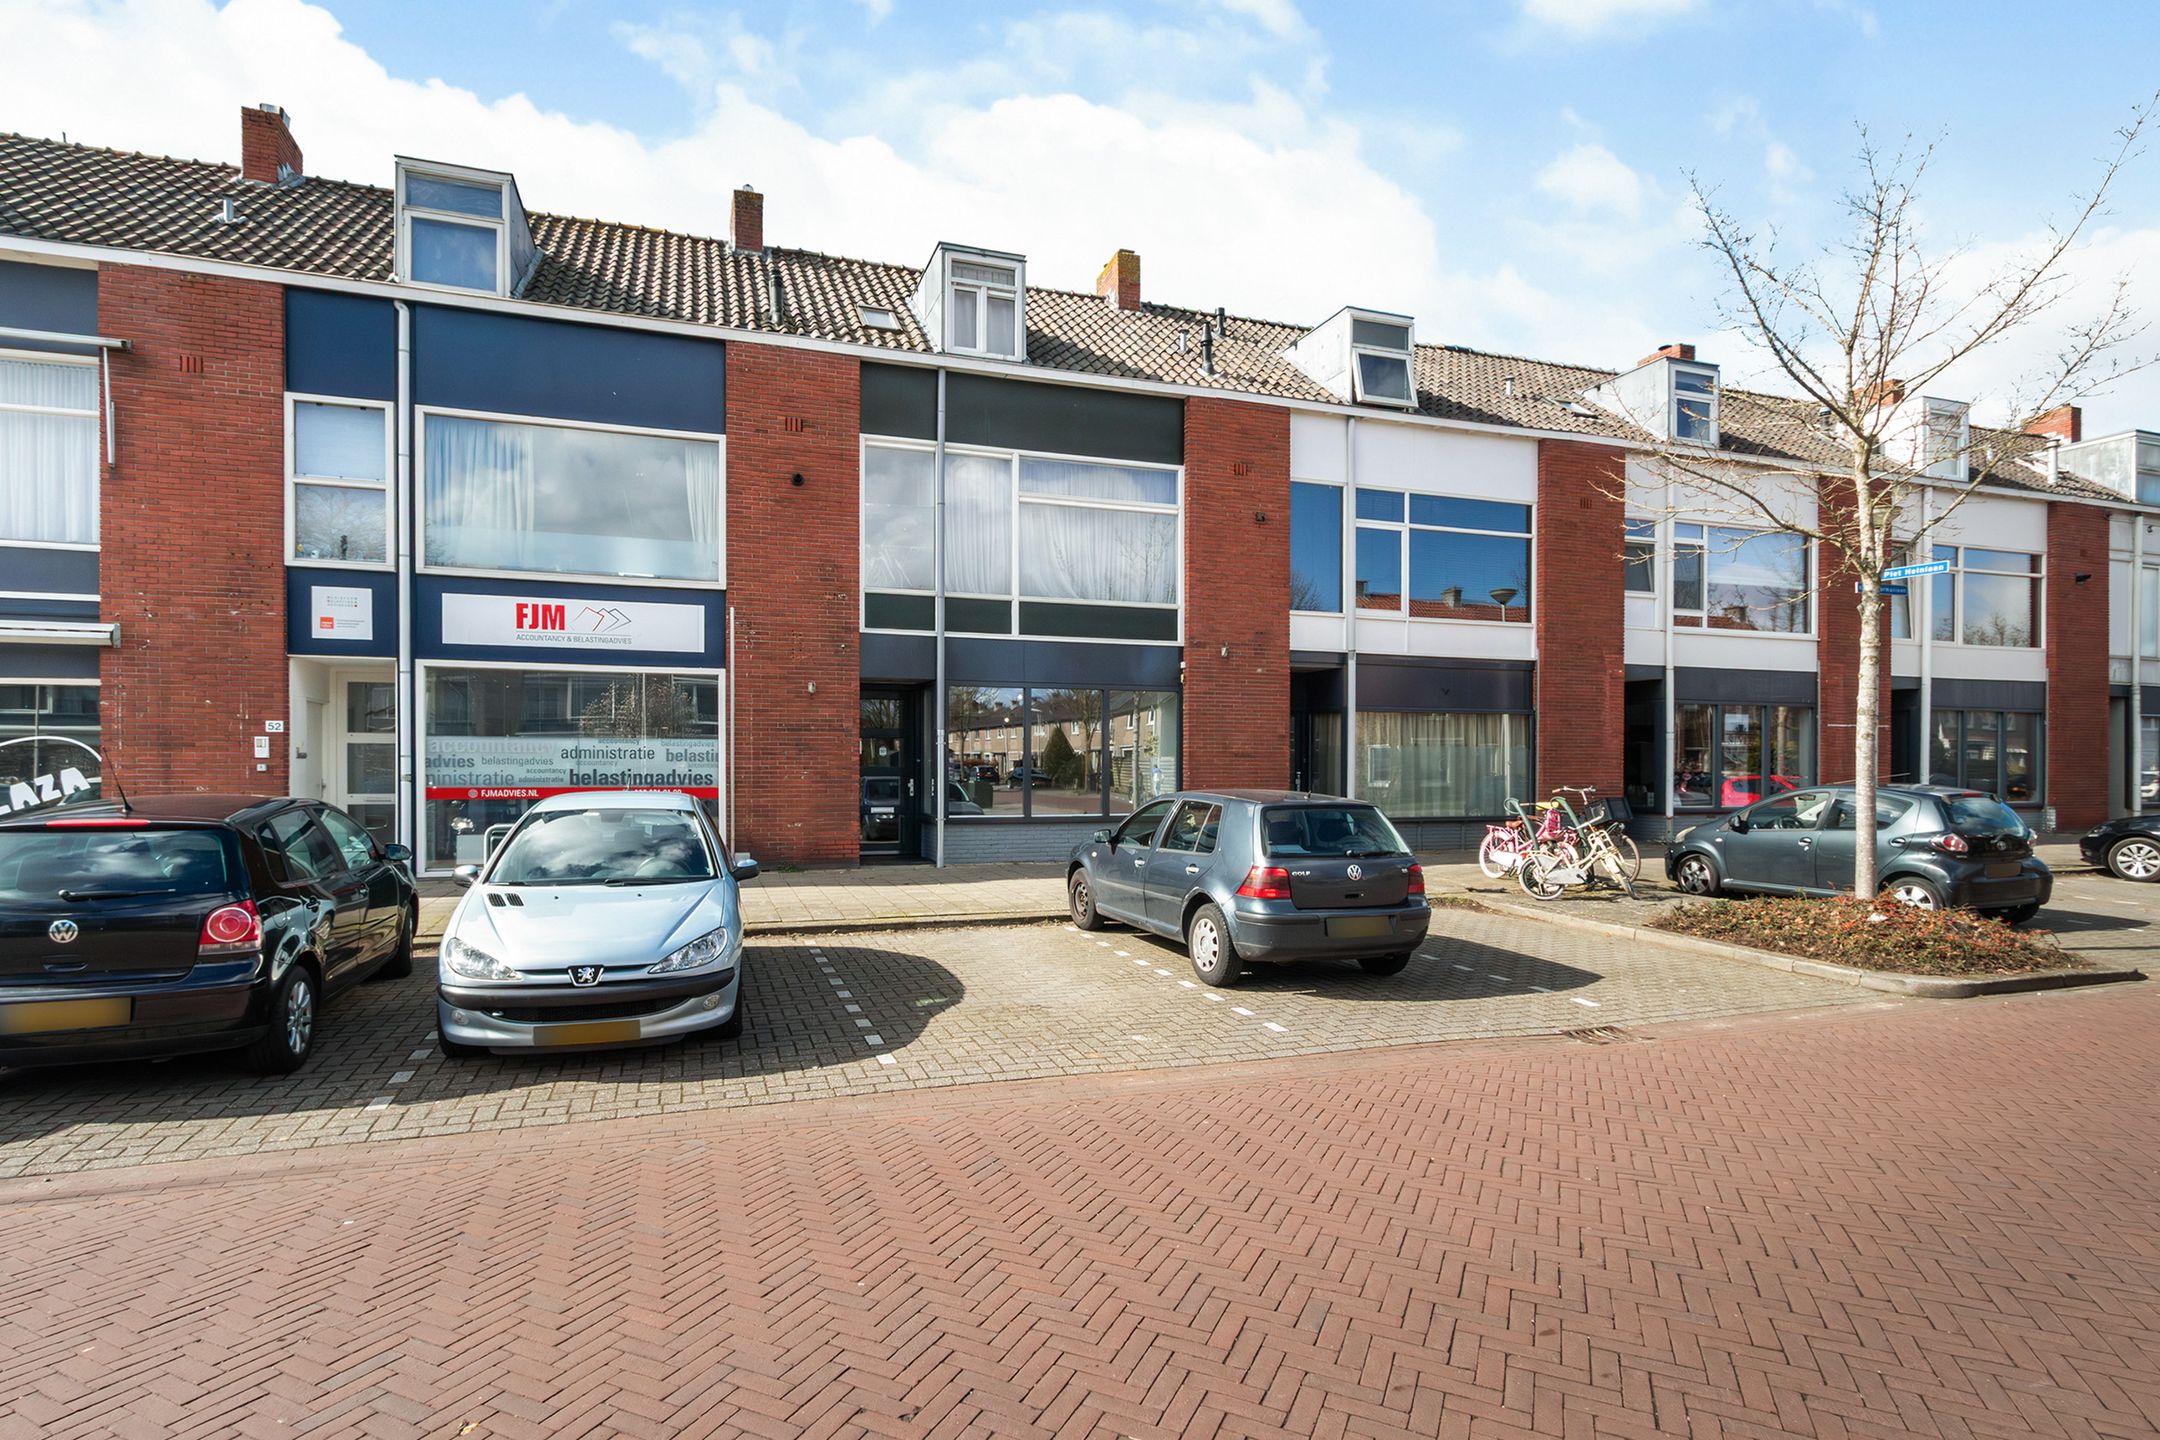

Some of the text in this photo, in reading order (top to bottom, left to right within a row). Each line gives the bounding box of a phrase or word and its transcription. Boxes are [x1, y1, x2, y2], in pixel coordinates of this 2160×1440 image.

[1905, 565, 1944, 575] Heinlaan
[516, 602, 565, 631] FJM
[516, 634, 632, 645] ACCOUNTANCY & BELASTINGADVIES
[267, 722, 282, 731] 52
[561, 745, 656, 760] administratie
[481, 756, 554, 767] belastingadvies
[575, 759, 619, 767] accountancy
[526, 767, 567, 775] accountancy
[569, 768, 714, 787] belastingadvies
[0, 767, 92, 815] AZA
[481, 789, 539, 797] FJMADVIES.NL
